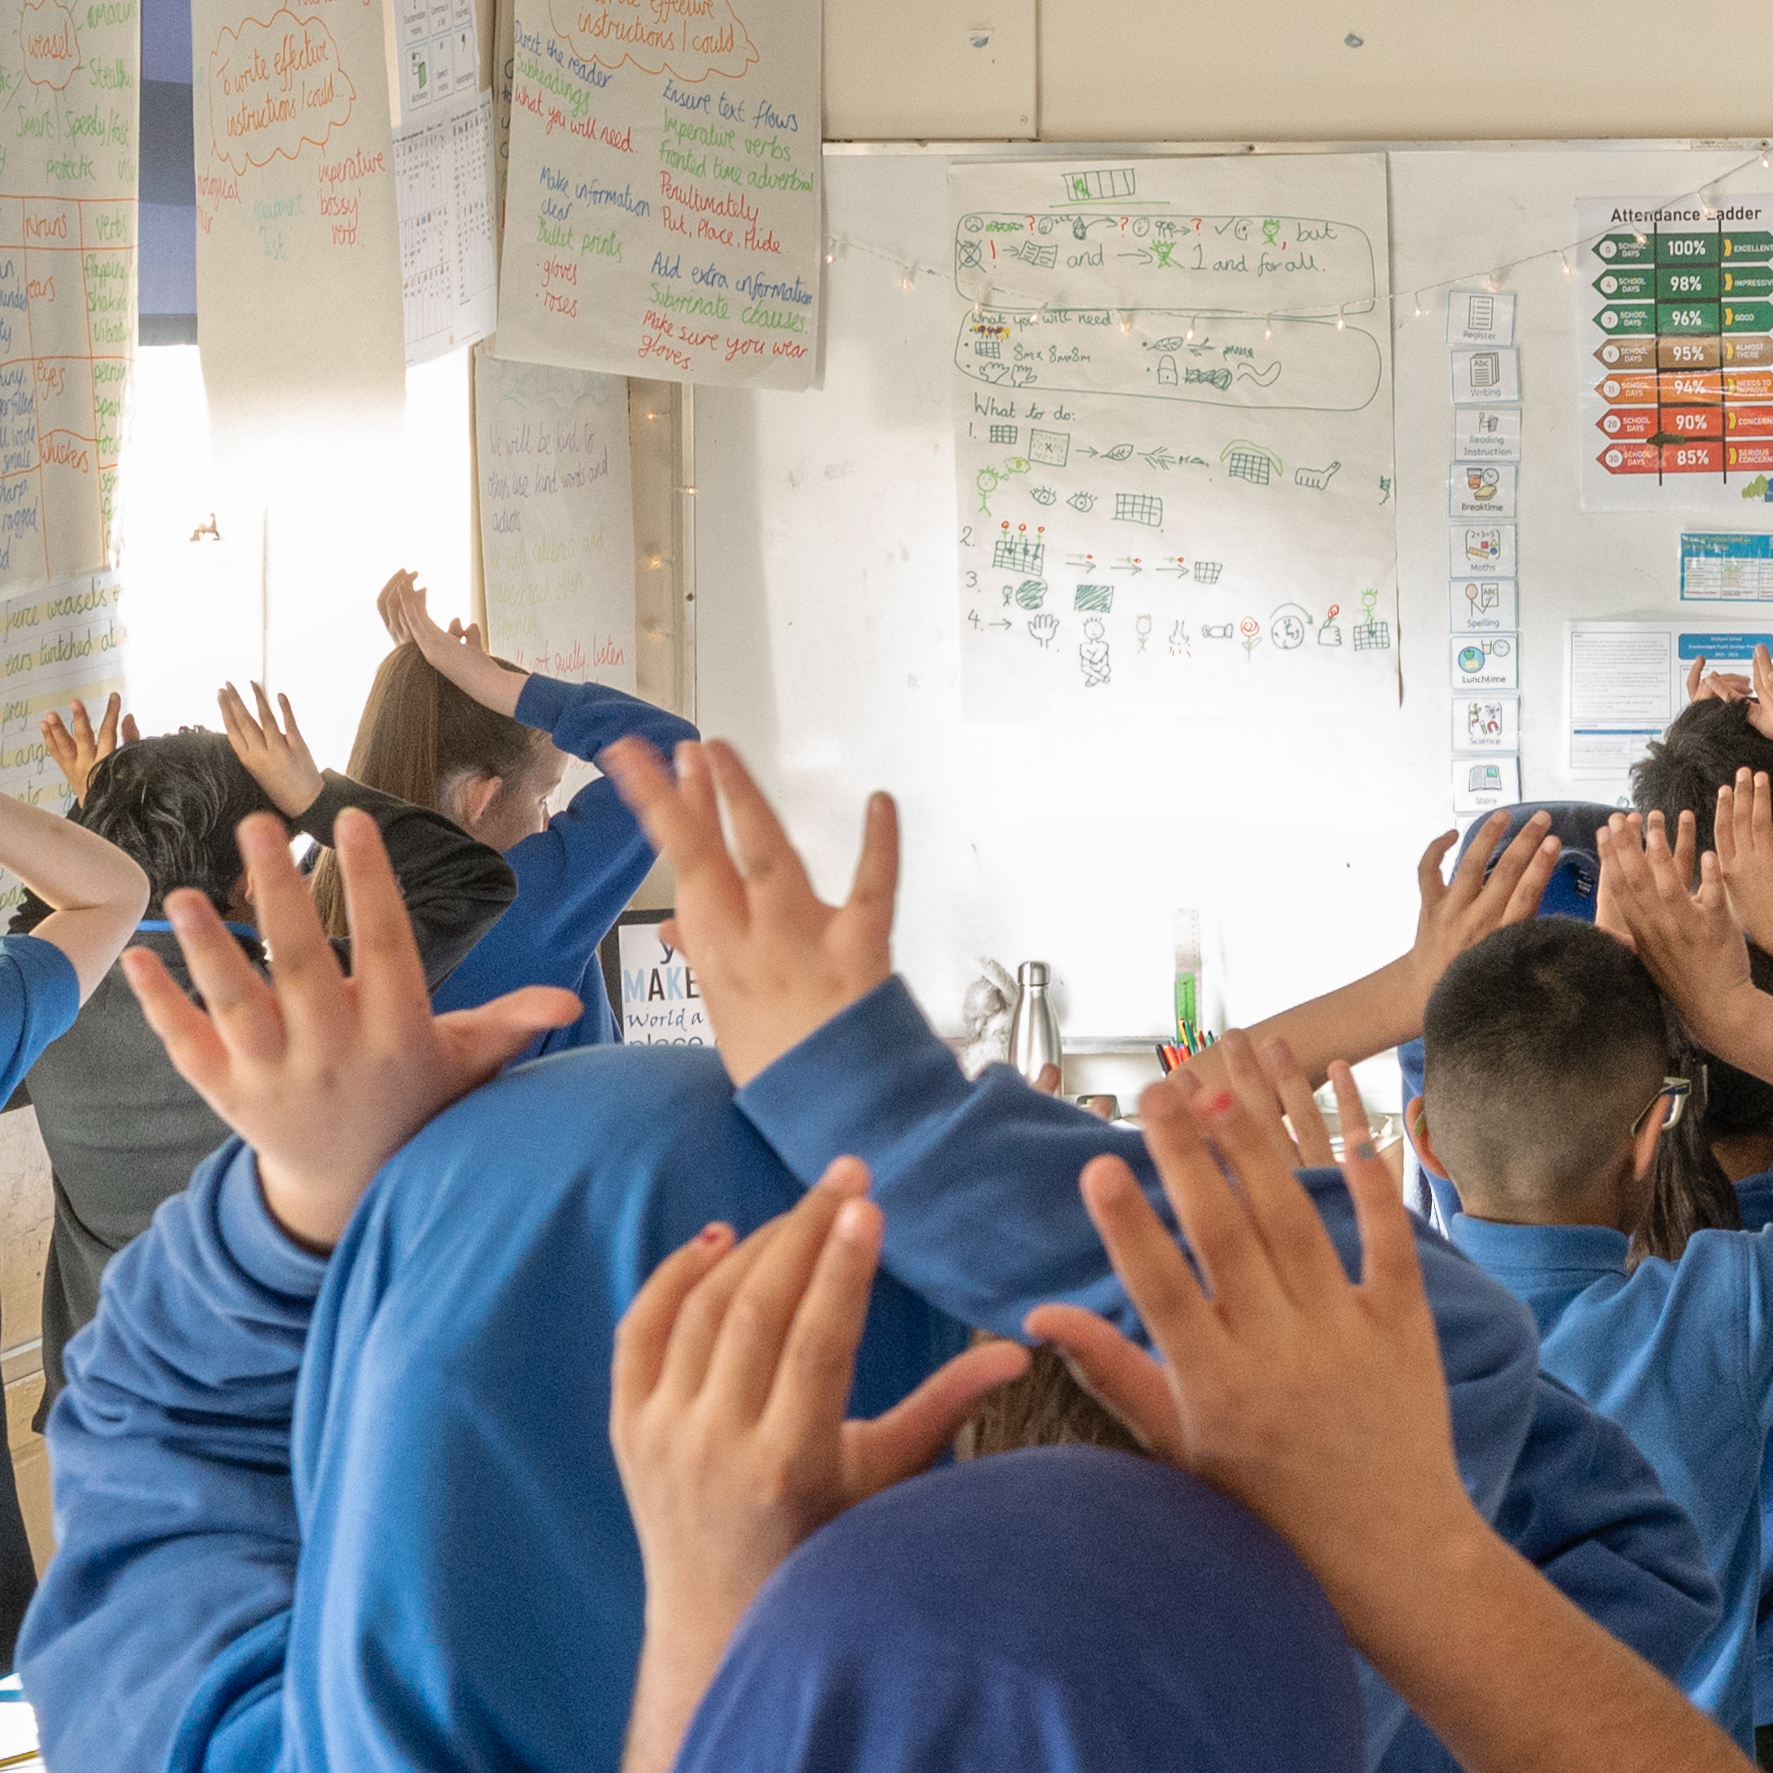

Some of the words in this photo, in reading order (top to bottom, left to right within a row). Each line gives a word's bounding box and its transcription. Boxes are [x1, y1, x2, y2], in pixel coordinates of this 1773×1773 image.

[577, 7, 674, 51] instructions
[235, 49, 270, 92] write
[546, 39, 565, 68] the
[568, 56, 612, 88] reader
[516, 52, 592, 118] Subheadings
[514, 84, 544, 117] What
[546, 106, 566, 135] you
[570, 117, 597, 140] will
[662, 79, 711, 115] Ensure
[718, 91, 746, 123] text
[752, 100, 799, 132] flows
[227, 93, 296, 137] instructions
[663, 108, 735, 151] Imperative
[744, 135, 792, 162] verbs
[659, 139, 707, 178] Fronted
[713, 158, 742, 186] time
[540, 165, 570, 199] Make
[575, 179, 650, 218] information
[1611, 208, 1700, 223] Attendance
[1706, 206, 1762, 220] adder
[536, 216, 574, 250] Bullet
[1296, 223, 1338, 241] but
[1668, 240, 1706, 256] 100%
[1734, 244, 1773, 253] EXCELLENT
[1067, 243, 1105, 267] and
[1213, 252, 1248, 272] and
[651, 251, 681, 279] Add
[692, 263, 729, 288] extra
[736, 272, 813, 305] information
[1670, 276, 1702, 292] 98%
[1622, 285, 1640, 293] DAYS
[544, 291, 578, 318] roses
[1043, 310, 1073, 323] will
[1079, 311, 1111, 324] need
[1624, 319, 1642, 327] DAYS
[1672, 310, 1702, 326] 96%
[642, 310, 674, 338] Make
[680, 325, 720, 351] sure
[725, 337, 765, 362] you
[772, 341, 808, 360] wear
[1463, 330, 1497, 341] Register
[1673, 346, 1704, 361] 95%
[1735, 343, 1764, 351] ALMOST
[1473, 359, 1489, 368] Abc
[36, 360, 65, 402] eyes
[1674, 380, 1706, 395] 94%
[1470, 387, 1502, 399] Writing
[1625, 389, 1643, 397] DAYS
[974, 392, 1016, 419] What
[1025, 402, 1045, 421] to
[1626, 424, 1645, 432] DAYS
[1675, 415, 1707, 430] 90%
[1469, 435, 1505, 446] Reading
[1463, 447, 1512, 457] Instruction
[1677, 450, 1709, 465] 85%
[1738, 449, 1770, 457] SERIOUS
[1627, 458, 1645, 466] DAYS
[1461, 502, 1504, 512] Breaktime
[1470, 563, 1496, 572] Maths
[1467, 618, 1500, 630] Spelling
[100, 619, 117, 648] at
[593, 632, 624, 667] listen
[1462, 675, 1506, 684] Lunchtime
[623, 966, 700, 1003] MAKE
[626, 1008, 687, 1032] World
[691, 1012, 704, 1026] a
